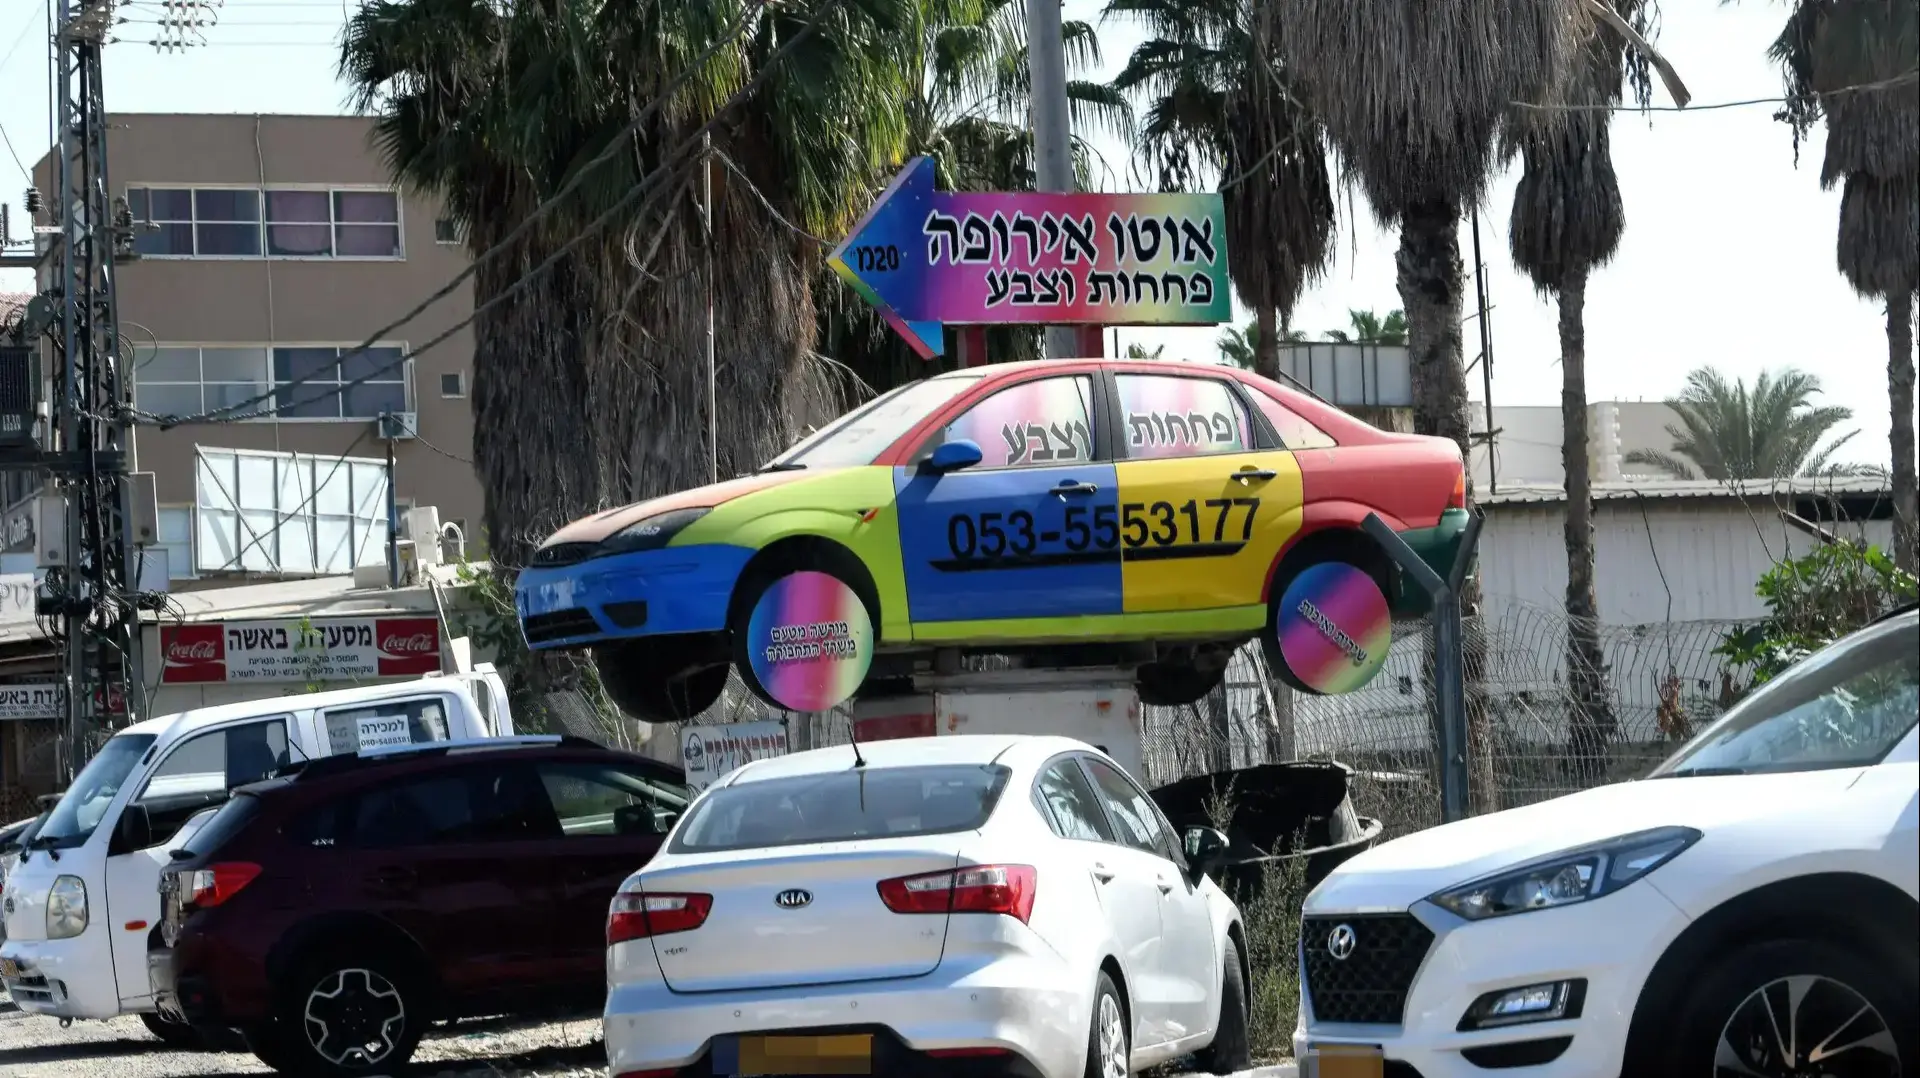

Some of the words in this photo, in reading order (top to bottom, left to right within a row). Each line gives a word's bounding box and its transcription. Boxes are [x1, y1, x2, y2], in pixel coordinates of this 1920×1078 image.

[924, 211, 1098, 265] אירופה
[1106, 213, 1216, 265] אוטו
[986, 269, 1076, 308] וצבע
[1087, 270, 1212, 306] פחחות
[1001, 420, 1092, 466] וצבע
[1128, 410, 1233, 447] פחחות
[948, 497, 1260, 560] 053-5553177
[228, 628, 288, 651] באשה
[771, 624, 806, 642] מטעם
[809, 621, 848, 638] מורשה
[766, 642, 820, 661] התחבורה
[823, 639, 856, 656] משרד
[361, 719, 405, 734] למכירה
[780, 891, 807, 905] KIA
